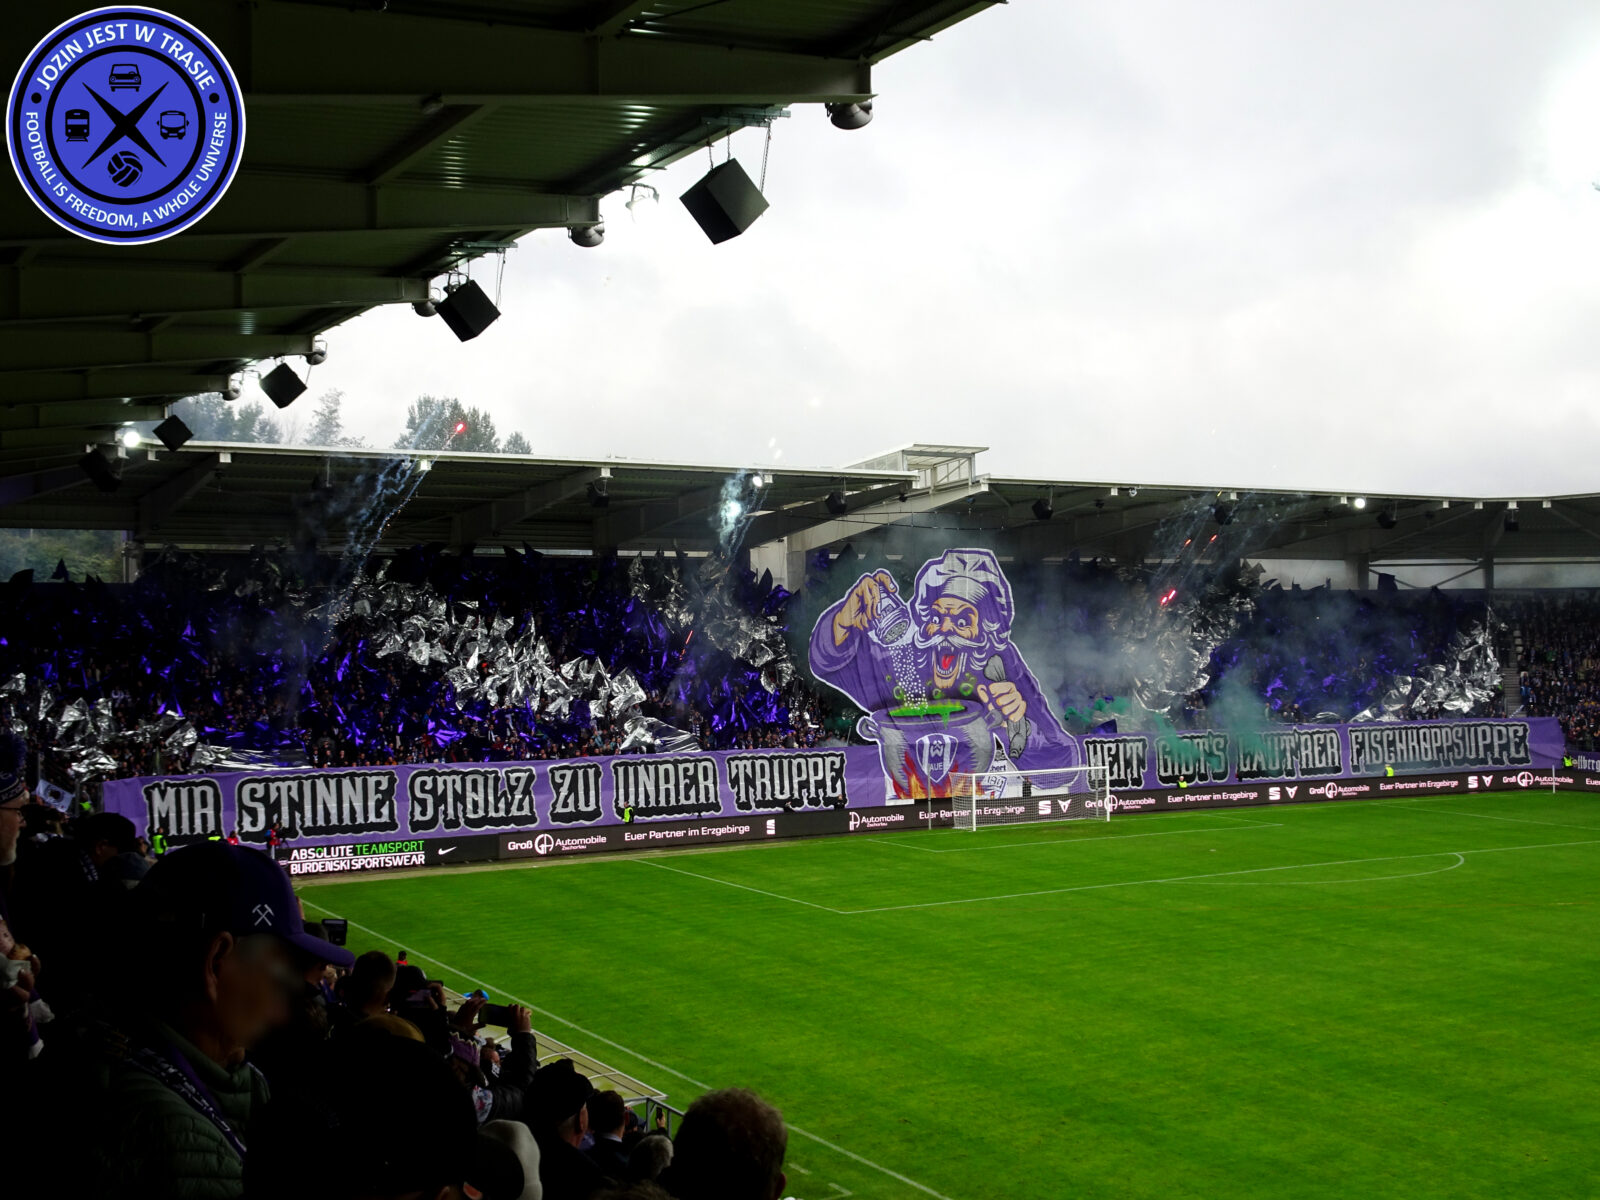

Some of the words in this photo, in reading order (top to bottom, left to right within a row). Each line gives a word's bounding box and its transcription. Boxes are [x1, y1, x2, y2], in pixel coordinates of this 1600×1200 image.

[1088, 741, 1143, 781] HEIT
[1351, 725, 1527, 766] FISCHKOPPSUPPE
[1395, 781, 1419, 789] Partner
[1427, 779, 1459, 789] Erzgebirge
[1585, 777, 1600, 786] Eue
[241, 775, 391, 833] STINNE
[413, 772, 533, 822] STOLZ
[554, 768, 598, 814] ZU
[729, 755, 843, 803] TRUPPE
[1338, 785, 1370, 793] Automobile
[1118, 797, 1156, 807] Automobile
[1168, 795, 1184, 803] Euer
[1185, 794, 1212, 802] Partner
[1213, 792, 1221, 800] im
[1222, 790, 1258, 801] Erzgebirge
[861, 813, 905, 824] Automobile
[940, 809, 971, 819] Partner
[624, 831, 648, 841] Euer
[649, 829, 687, 840] Partner
[688, 826, 700, 837] im
[701, 824, 751, 837] Erzgebirge
[507, 840, 533, 851] Groß
[555, 834, 607, 847] Automobile
[290, 845, 354, 861] ABSOLUTE
[355, 840, 425, 856] TEAMSPORT
[290, 860, 351, 875] BURDENSKI
[351, 853, 426, 870] SPORTSWEAR
